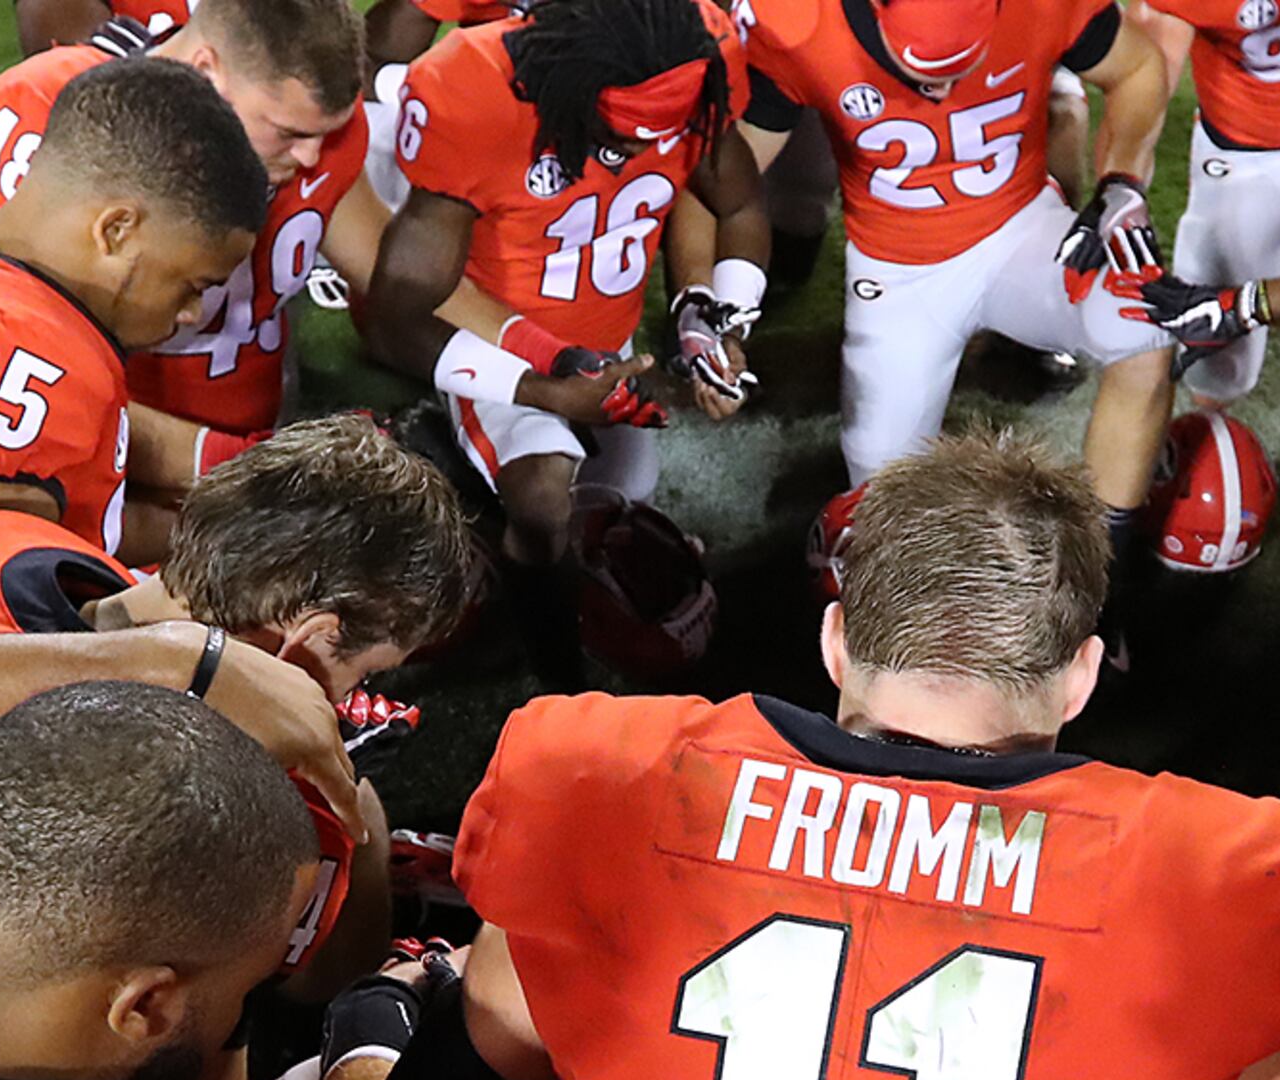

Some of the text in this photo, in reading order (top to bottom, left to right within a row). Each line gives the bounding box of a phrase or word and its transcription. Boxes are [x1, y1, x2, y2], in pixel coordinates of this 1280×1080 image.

[855, 91, 1026, 209] 25
[540, 172, 675, 301] 16
[716, 758, 1047, 917] FROMM
